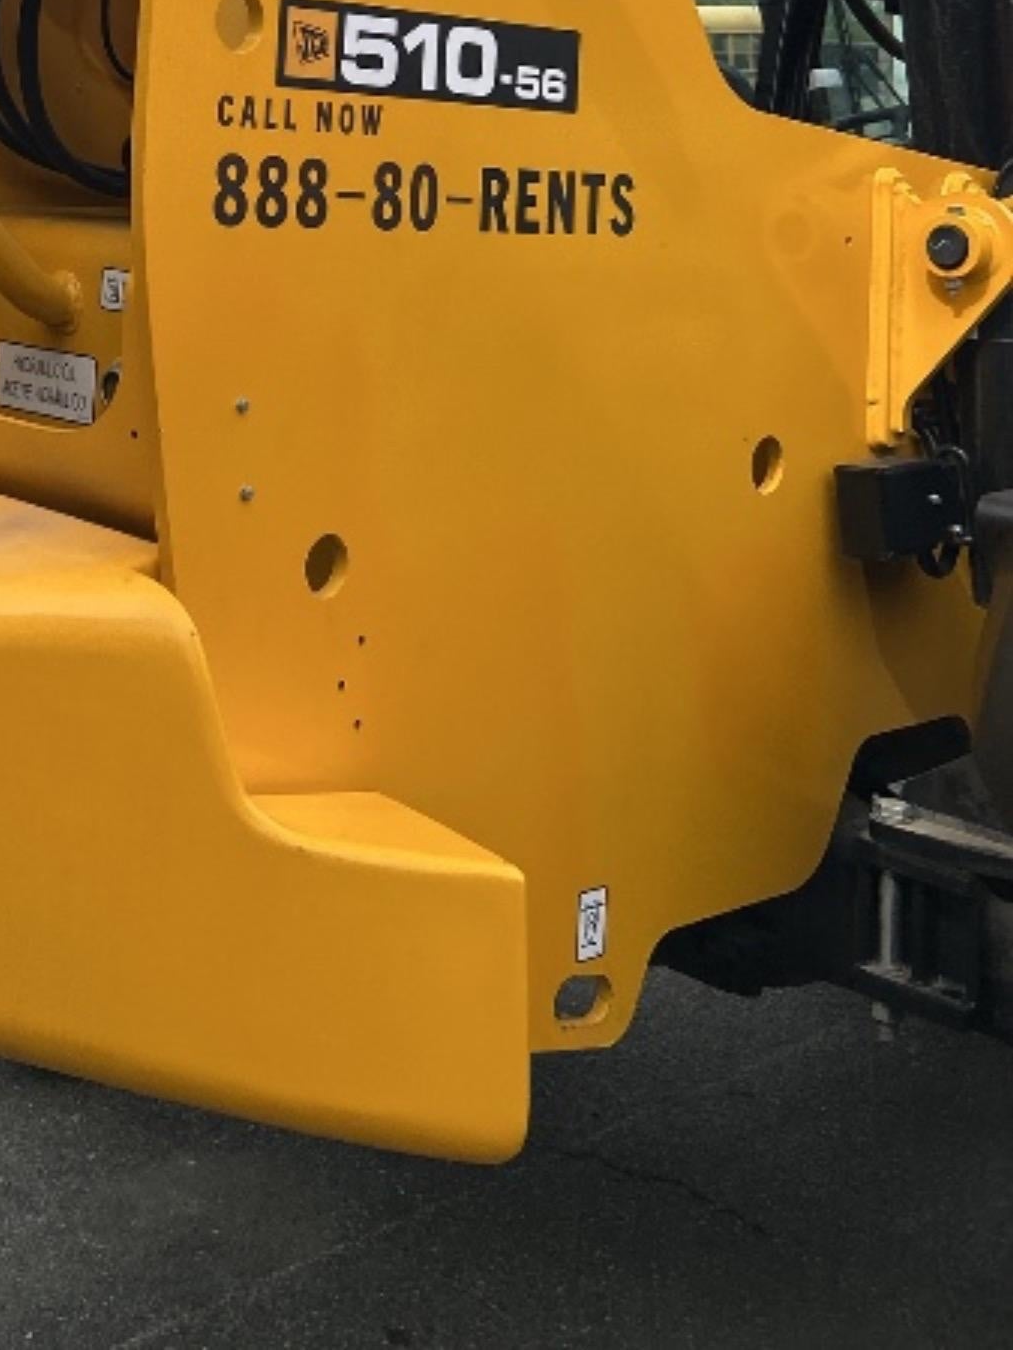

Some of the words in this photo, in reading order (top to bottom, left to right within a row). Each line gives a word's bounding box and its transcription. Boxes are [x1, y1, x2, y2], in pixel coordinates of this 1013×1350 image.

[217, 95, 297, 131] CALL
[316, 100, 384, 136] NOW
[213, 152, 635, 238] 888-80-RENTS
